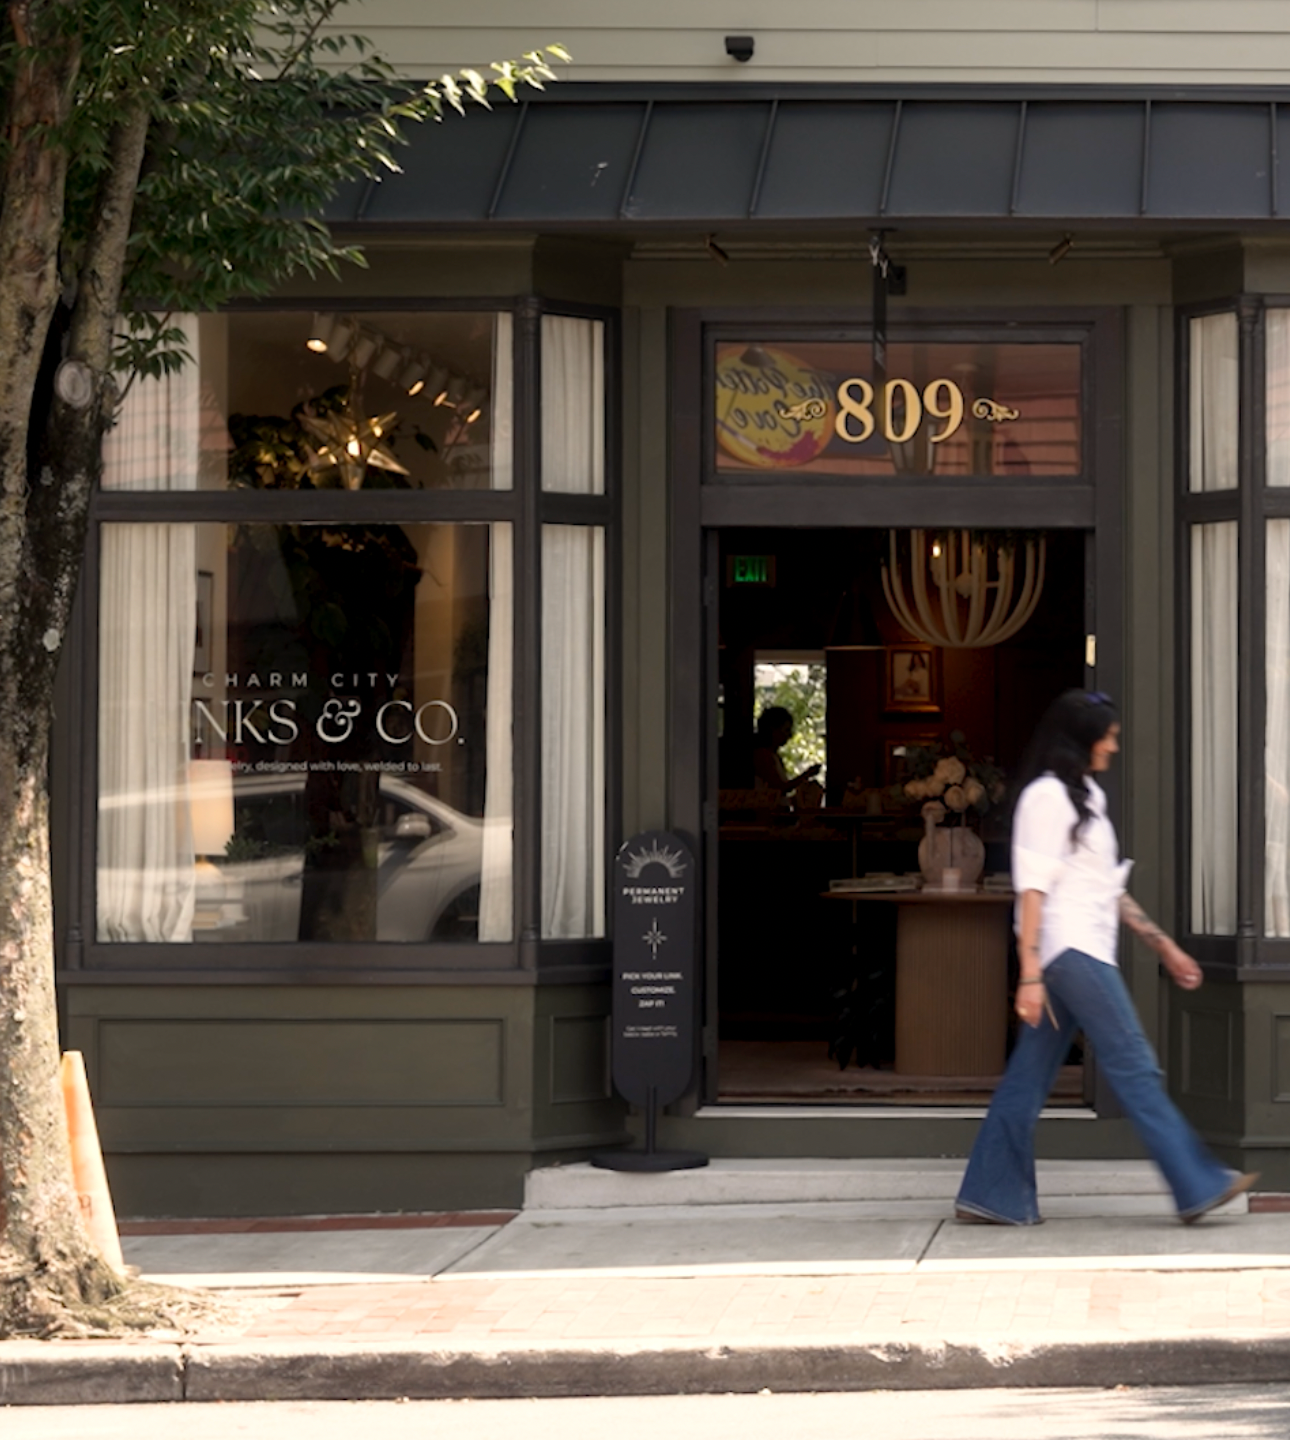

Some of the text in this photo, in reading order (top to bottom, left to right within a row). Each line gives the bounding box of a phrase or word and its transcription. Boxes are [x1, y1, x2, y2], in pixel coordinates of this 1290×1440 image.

[834, 378, 964, 443] 809
[735, 556, 767, 582] EXIT
[202, 673, 399, 688] CHARM CITY
[188, 699, 465, 745] NKS & CO.
[255, 760, 308, 773] designed
[309, 760, 336, 772] with
[337, 760, 363, 773] love,
[363, 760, 405, 772] welded
[407, 761, 420, 772] to
[421, 761, 443, 773] last.
[622, 887, 685, 896] PERMANENT
[631, 895, 679, 904] JEWELRY
[641, 972, 662, 980] YOUR
